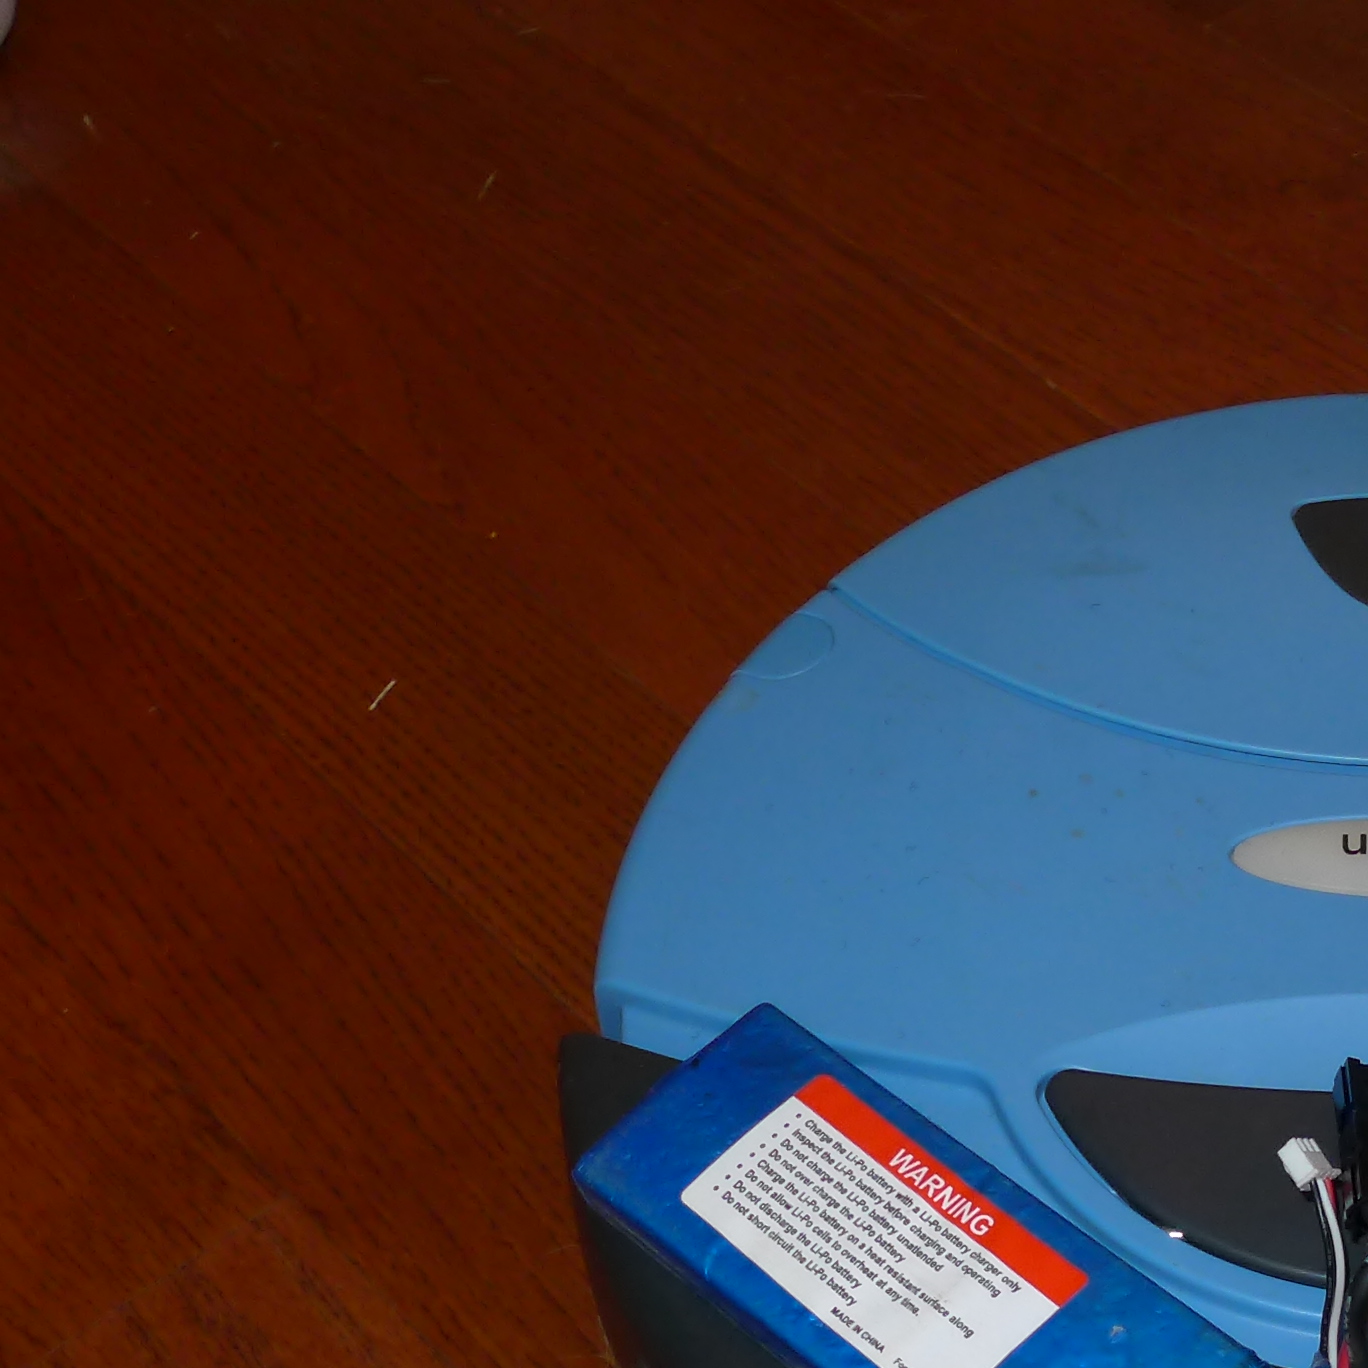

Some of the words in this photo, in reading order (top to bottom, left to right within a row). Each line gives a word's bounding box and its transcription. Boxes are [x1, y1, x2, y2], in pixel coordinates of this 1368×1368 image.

[731, 1179, 747, 1193] Do
[743, 1190, 762, 1205] not
[758, 1202, 798, 1236] discharge
[795, 1231, 812, 1247] the
[809, 1242, 833, 1264] Li-Po
[829, 1259, 862, 1289] battery
[743, 1168, 758, 1182] Do
[755, 1179, 773, 1194] not
[769, 1191, 793, 1210] allow
[790, 1205, 813, 1228] Li-Po
[811, 1225, 833, 1244] cells
[830, 1239, 842, 1251] to
[839, 1248, 878, 1282] overheat
[874, 1278, 888, 1290] at
[884, 1286, 903, 1302] any
[767, 1147, 782, 1161] Do
[779, 1158, 797, 1174] not
[793, 1170, 815, 1187] over
[811, 1184, 841, 1209] charge
[838, 1205, 854, 1221] the
[851, 1216, 876, 1237] Li-Po
[873, 1232, 906, 1263] battery
[779, 1137, 794, 1151] Do
[791, 1148, 809, 1163] not
[805, 1159, 834, 1184] charge
[832, 1180, 848, 1195] the
[845, 1190, 869, 1212] Li-Po
[867, 1208, 898, 1236] battery
[790, 1127, 824, 1155] Inspect
[819, 1150, 835, 1165] the
[832, 1161, 856, 1182] Li-Po
[854, 1177, 885, 1205] battery
[881, 1200, 911, 1226] before
[908, 1224, 946, 1256] charging
[943, 1252, 965, 1267] and
[960, 1264, 1001, 1298] operating
[804, 1118, 833, 1144] Charge
[831, 1140, 847, 1155] the
[844, 1150, 868, 1172] Li-Po
[865, 1167, 896, 1195] battery
[894, 1191, 914, 1208] with
[911, 1205, 920, 1214] a
[918, 1209, 942, 1232] Li-Po
[939, 1226, 972, 1255] battery
[968, 1250, 1003, 1276] charger
[1000, 1275, 1022, 1293] only
[888, 1147, 994, 1235] WARNING
[720, 1189, 735, 1204] Do
[732, 1201, 750, 1216] not
[745, 1212, 771, 1234] short
[767, 1230, 795, 1254] circuit
[790, 1248, 807, 1264] the
[804, 1259, 828, 1281] Li-Po
[825, 1276, 857, 1307] battery
[756, 1158, 786, 1185] Charge
[783, 1181, 799, 1196] the
[796, 1191, 820, 1213] Li-Po
[817, 1208, 849, 1237] battery
[846, 1233, 860, 1245] on
[857, 1242, 866, 1250] a
[863, 1245, 886, 1267] heat
[882, 1263, 922, 1295] resistant
[917, 1291, 950, 1317] surface
[947, 1315, 974, 1339] along
[829, 1305, 855, 1328] MADE
[851, 1323, 863, 1334] IN
[859, 1330, 885, 1353] CHINA
